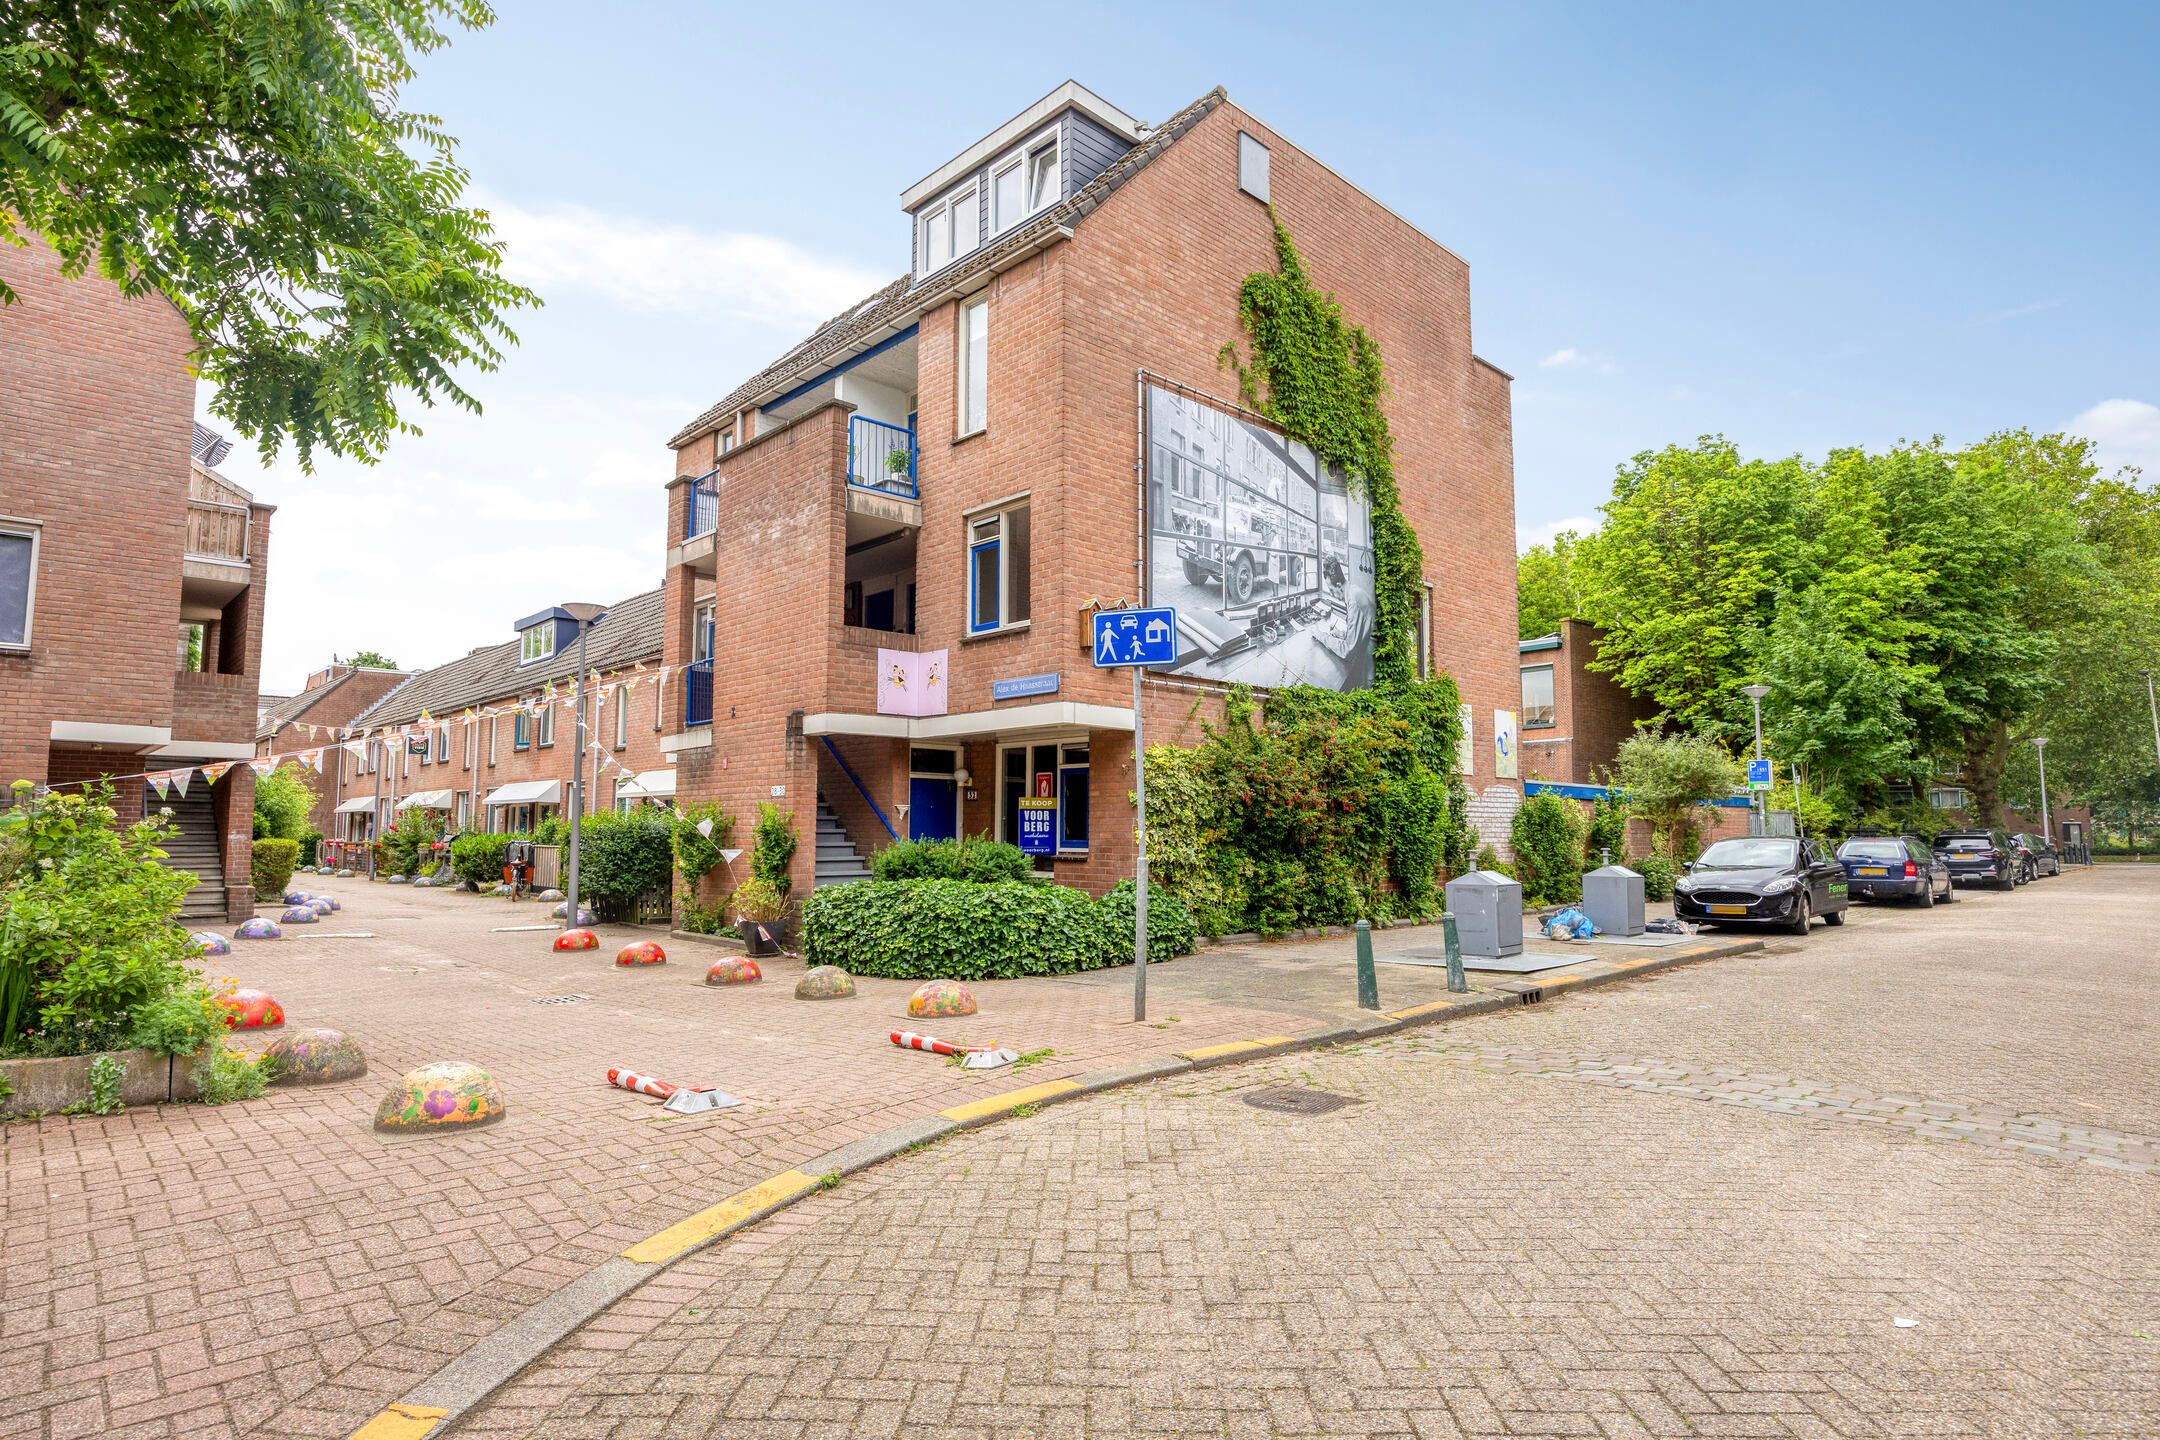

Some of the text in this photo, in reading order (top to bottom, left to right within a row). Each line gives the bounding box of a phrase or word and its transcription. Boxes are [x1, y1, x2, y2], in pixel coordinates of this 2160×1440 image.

[996, 684, 1009, 693] Alex
[1010, 682, 1019, 691] de
[1750, 762, 1756, 772] P
[1024, 810, 1050, 821] VOOR
[1024, 821, 1050, 832] BERG
